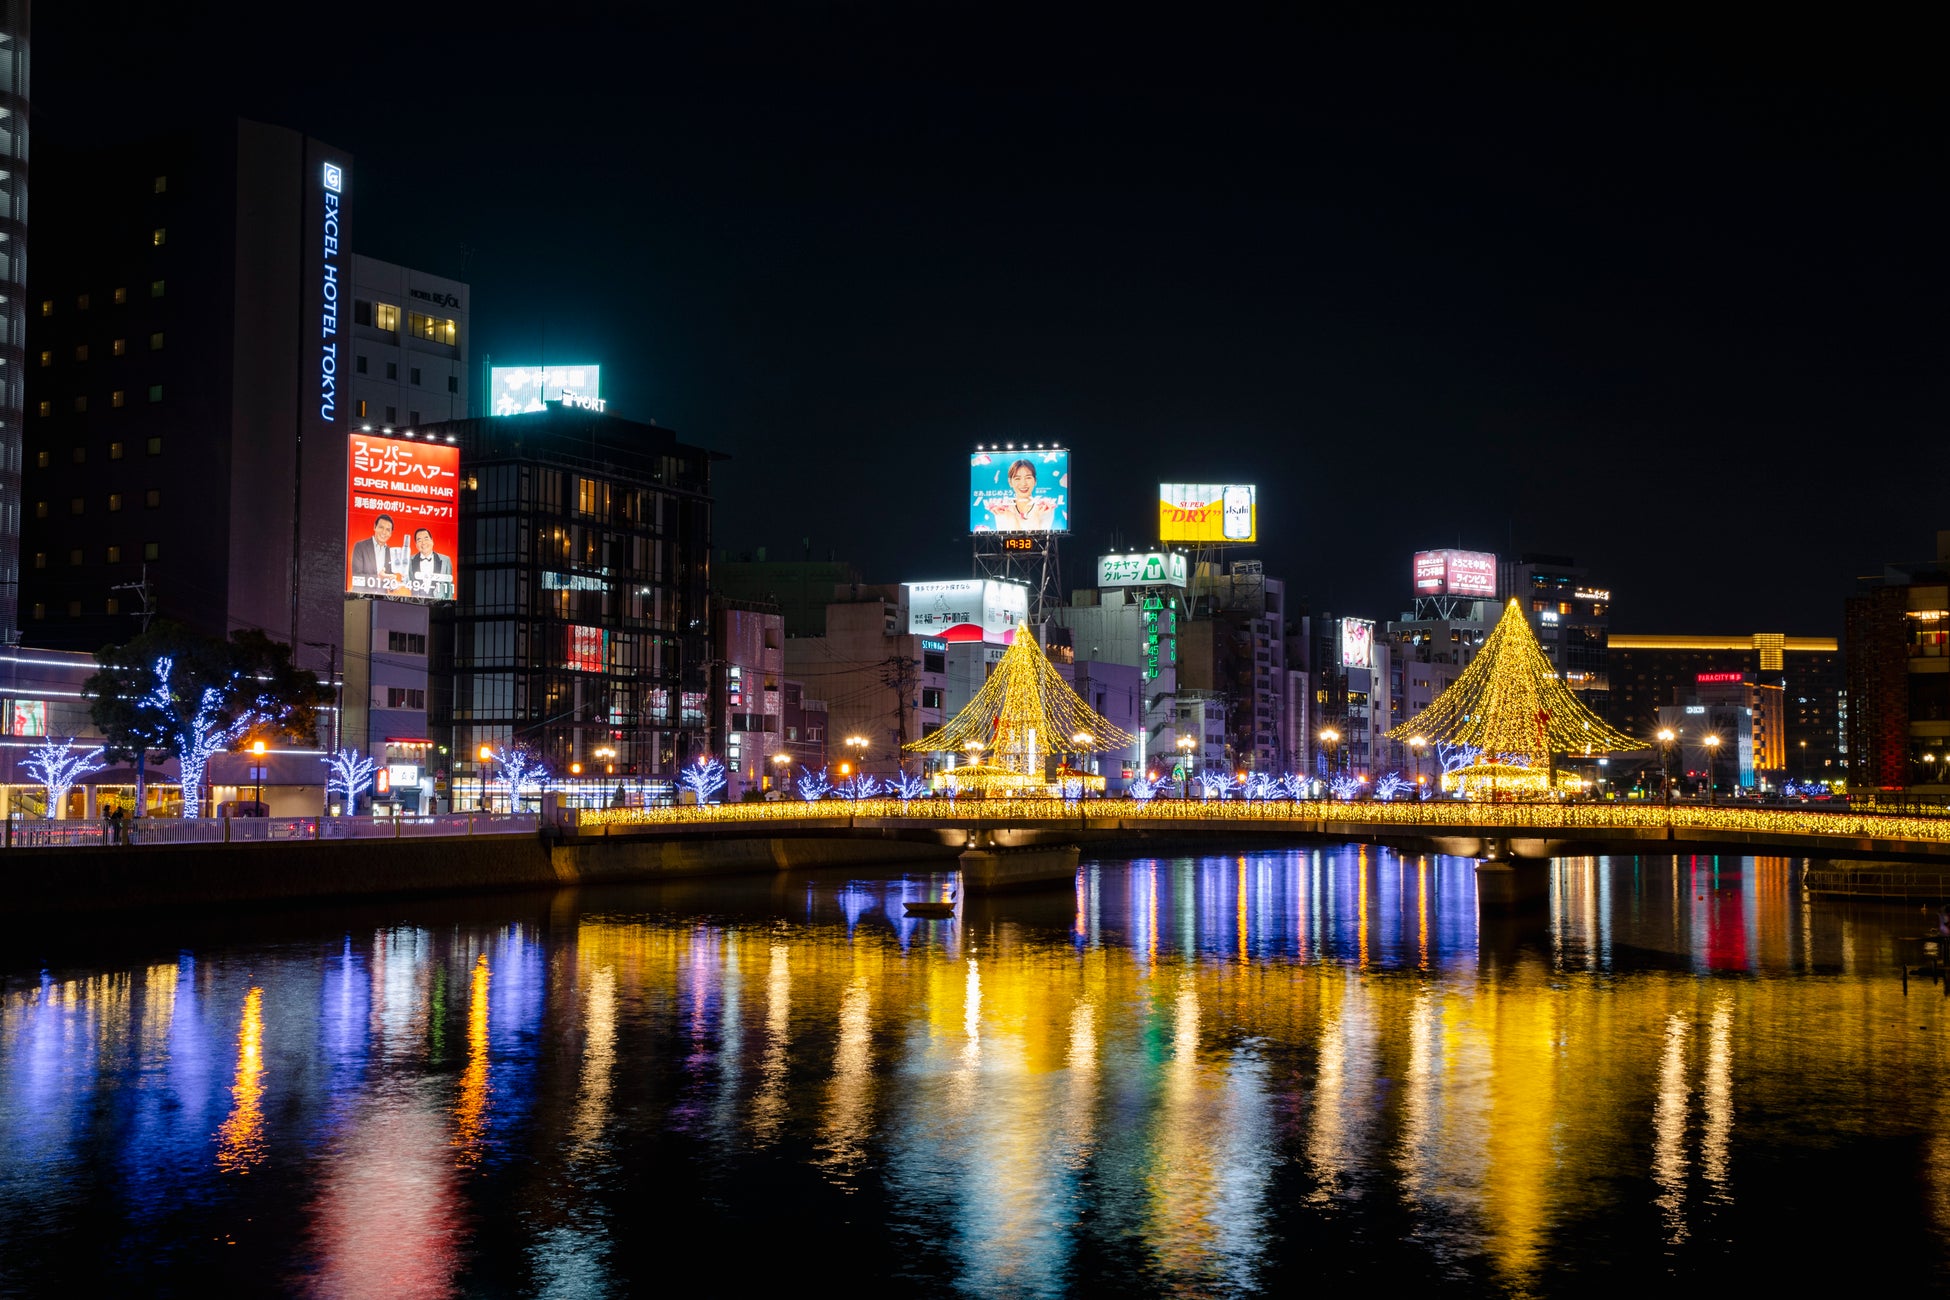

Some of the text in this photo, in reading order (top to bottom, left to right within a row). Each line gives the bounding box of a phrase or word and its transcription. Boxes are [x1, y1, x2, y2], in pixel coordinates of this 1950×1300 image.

[321, 192, 338, 422] EXCEL HOTEL TOKYU
[355, 441, 413, 460] スーパー
[354, 456, 455, 479] ミリオンヘアー
[354, 477, 453, 497] SUPER MILLION HAIR
[1226, 505, 1249, 514] Asahi
[1104, 560, 1140, 571] ウチヤマ
[1104, 571, 1140, 581] グループ
[1456, 573, 1487, 584] ラインビル
